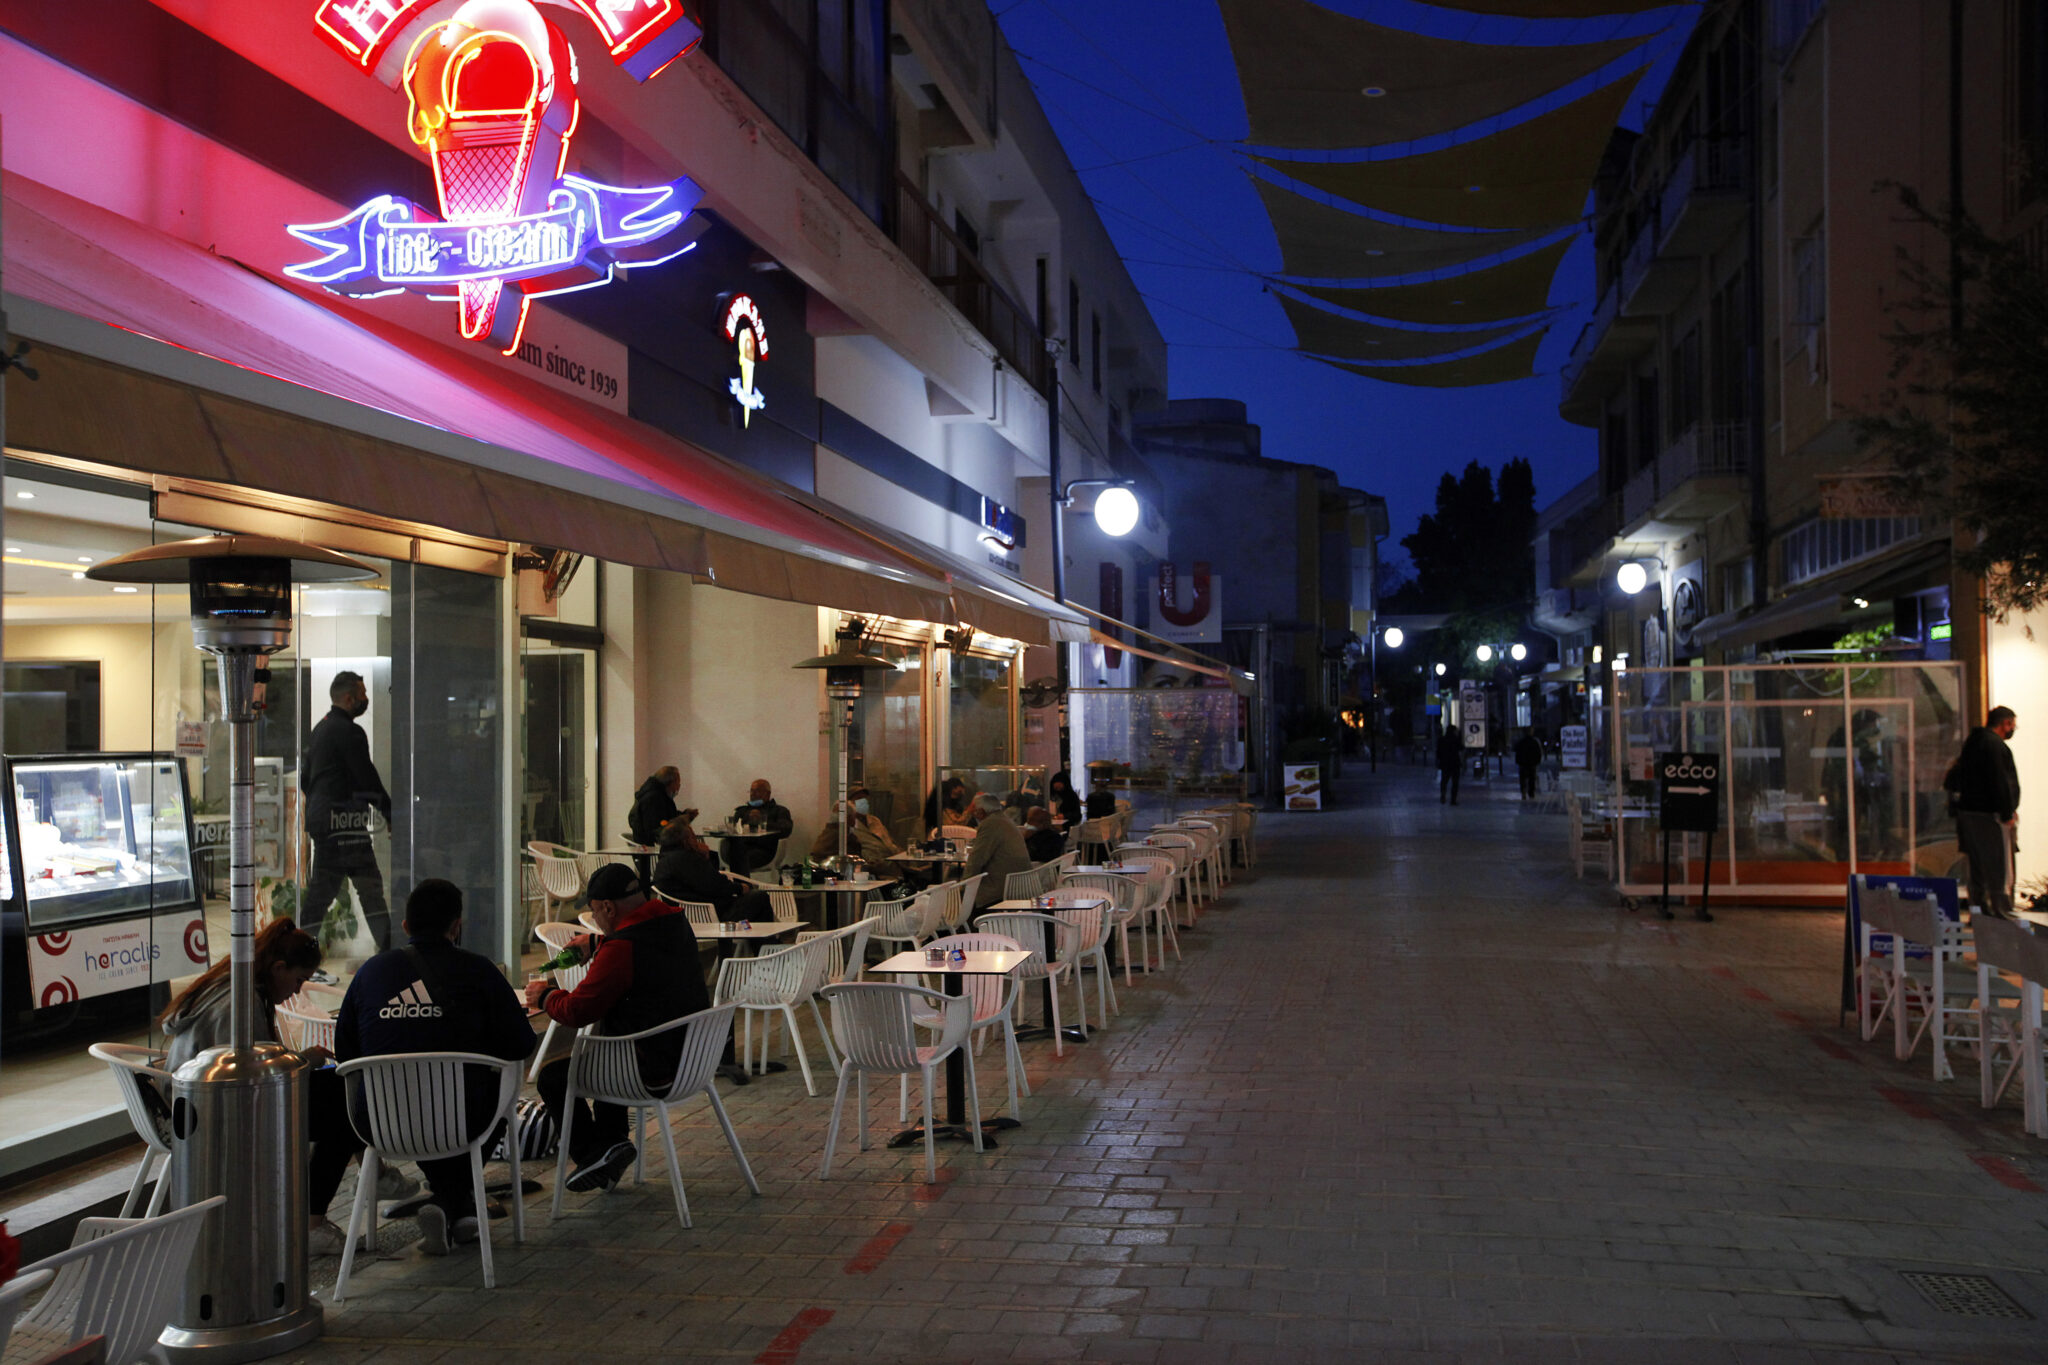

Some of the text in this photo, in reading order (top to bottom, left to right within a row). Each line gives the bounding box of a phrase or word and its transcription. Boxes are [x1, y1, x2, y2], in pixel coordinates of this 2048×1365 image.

[546, 345, 586, 386] since
[590, 369, 618, 400] 1939
[1664, 764, 1716, 779] ecco
[84, 940, 161, 973] heraclis
[379, 1003, 443, 1019] adidas
